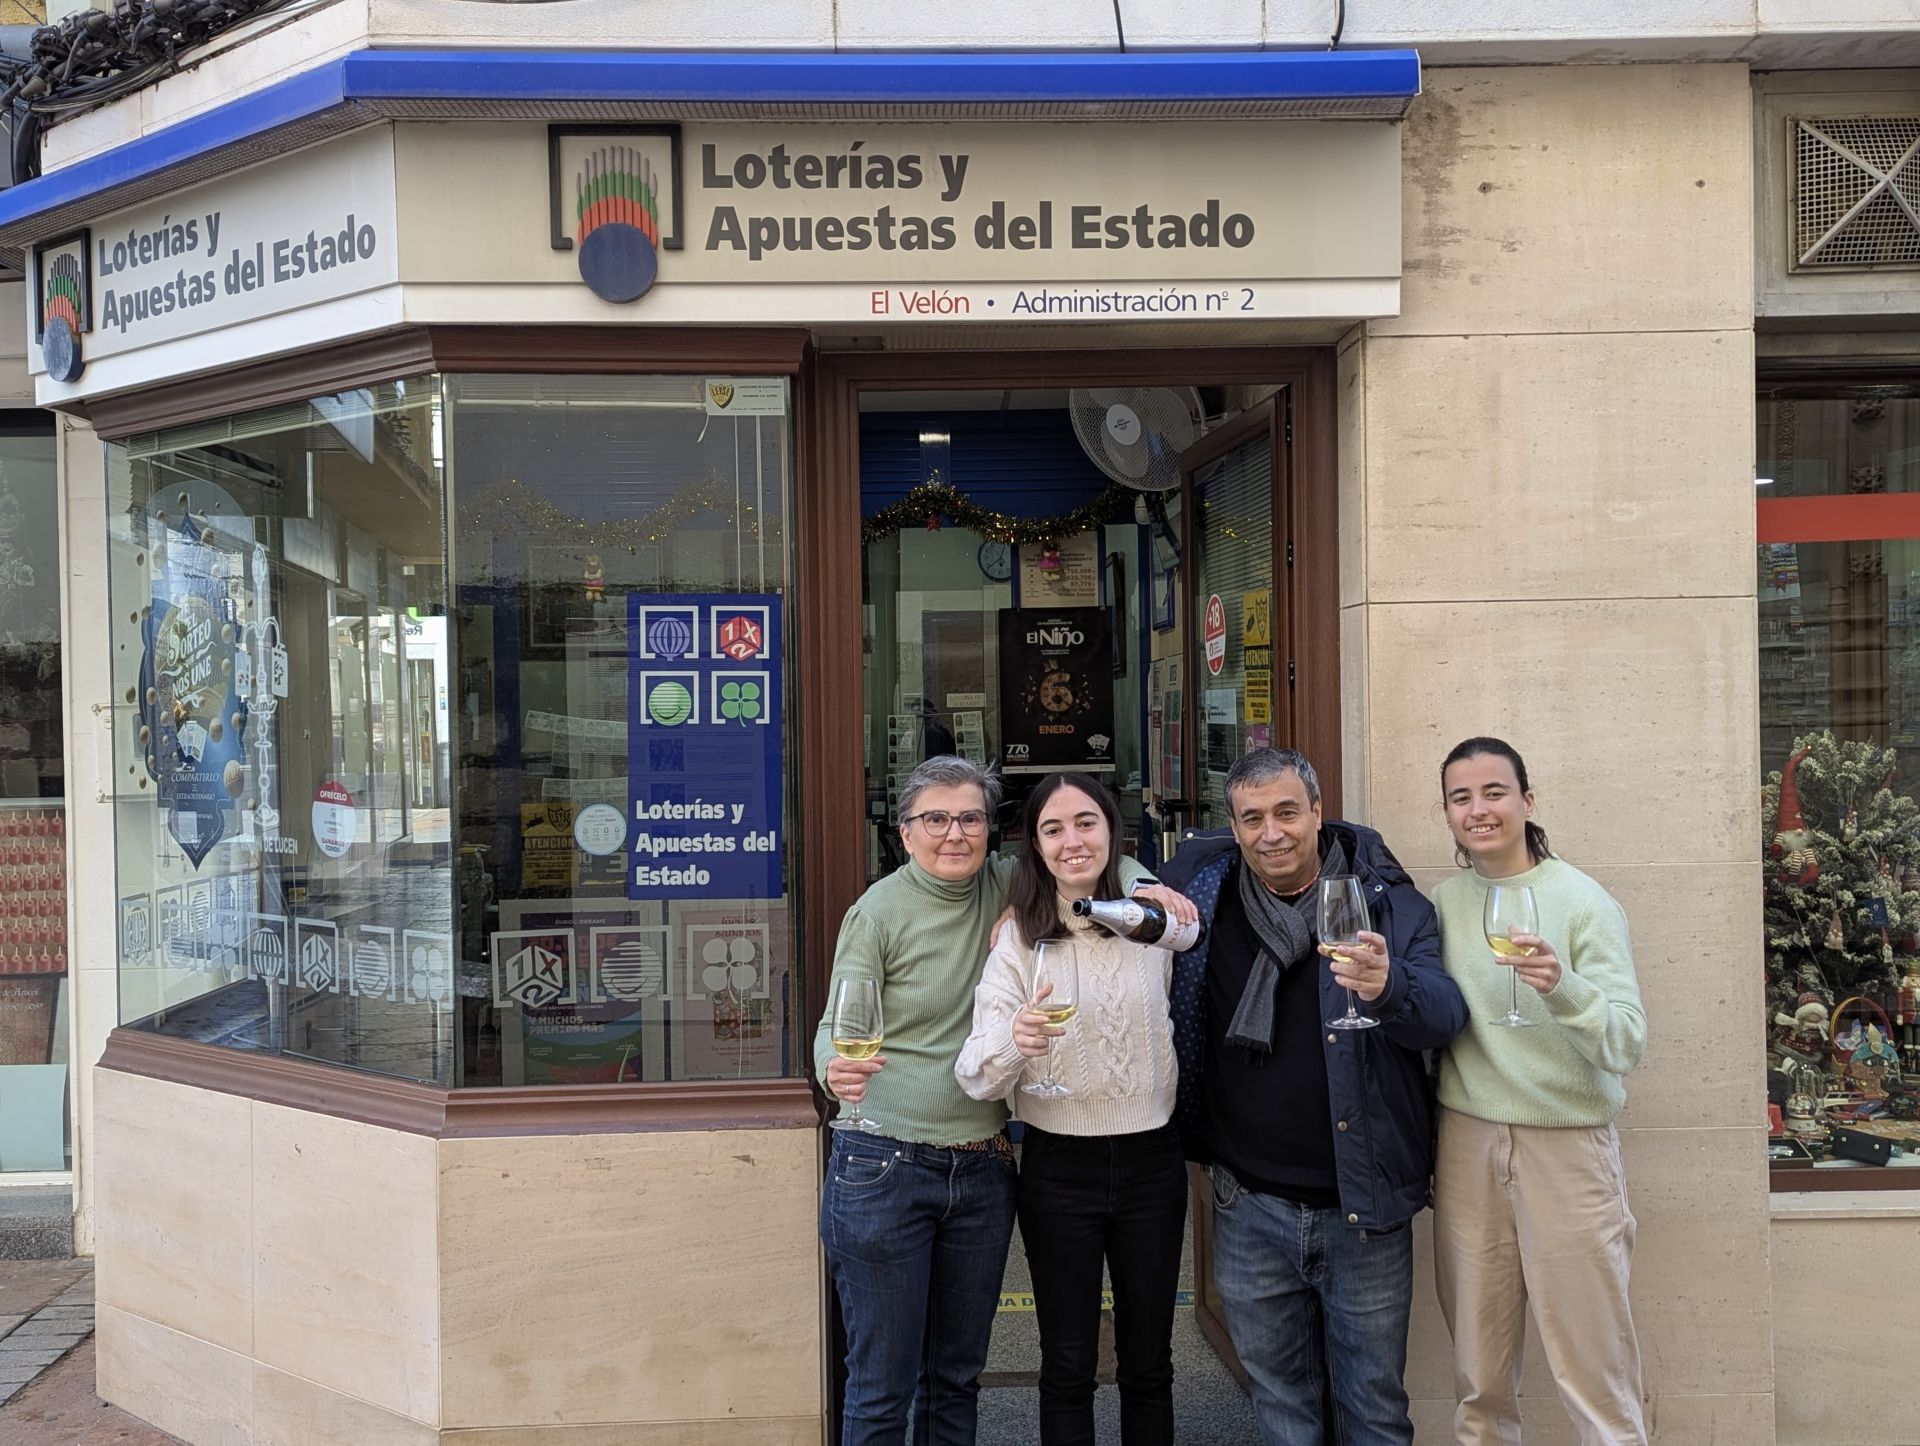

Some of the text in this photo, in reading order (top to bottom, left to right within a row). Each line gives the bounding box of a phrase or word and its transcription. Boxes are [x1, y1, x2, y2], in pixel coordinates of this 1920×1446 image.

[702, 141, 969, 201] Loterías y
[706, 201, 1256, 260] Apuestas del Estado
[99, 211, 221, 277] Loterías y
[102, 213, 377, 333] Apuestas del Estado
[871, 291, 889, 314] El
[899, 290, 970, 314] Velón
[1012, 287, 1198, 315] Administración
[1240, 289, 1255, 311] 2
[1208, 602, 1220, 629] +18
[1039, 626, 1085, 647] Niño
[1039, 724, 1074, 735] ENERO
[1006, 744, 1030, 754] 770
[171, 772, 220, 782] COMPARTIRLO
[320, 789, 347, 801] OFRÉCELO
[635, 799, 725, 820] Loterías
[731, 802, 745, 824] y
[635, 830, 776, 858] Apuestas del
[635, 864, 711, 886] Estado
[538, 1015, 584, 1025] MUCHOS
